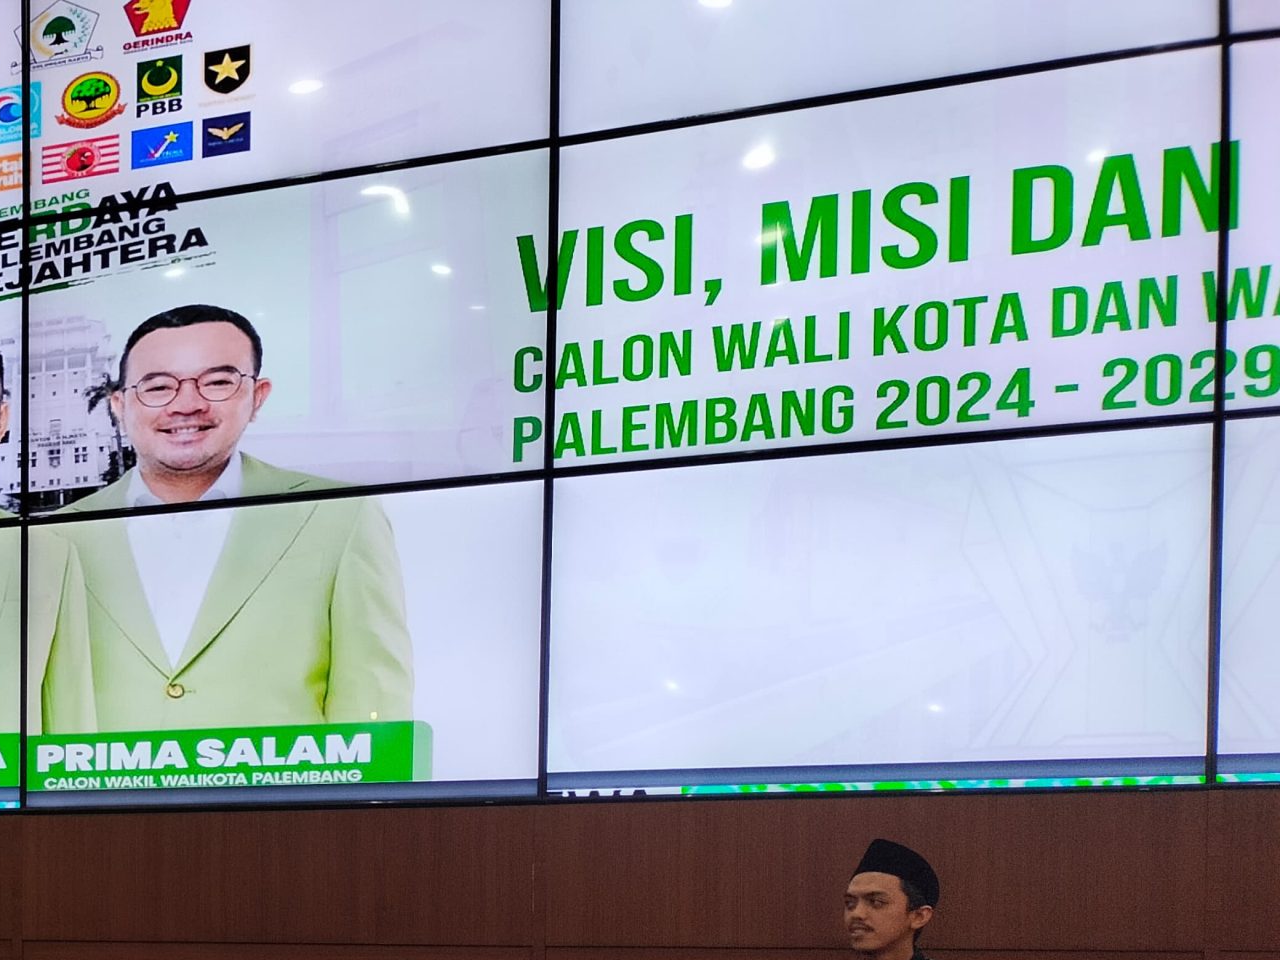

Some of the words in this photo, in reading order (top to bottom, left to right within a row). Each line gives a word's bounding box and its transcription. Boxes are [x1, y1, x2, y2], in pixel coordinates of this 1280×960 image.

[123, 31, 193, 51] GERINDRA
[136, 98, 183, 118] PBB
[516, 213, 722, 314] VISI,
[760, 175, 971, 286] MISI
[1011, 140, 1241, 256] DAN
[513, 329, 693, 394] CALON
[712, 310, 851, 372] WALI
[873, 292, 1029, 356] KOTA
[1051, 275, 1178, 338] DAN
[1201, 264, 1280, 323] W
[512, 384, 855, 463] PALEMBANG
[875, 367, 1035, 430] 2024
[1101, 343, 1280, 411] 2029
[37, 740, 188, 772] PRIMA
[196, 733, 372, 769] SALAM
[44, 777, 100, 789] CALON
[104, 776, 157, 789] WAKIL
[160, 773, 247, 787] WALIKOTA
[252, 769, 362, 784] PALEMBANG
